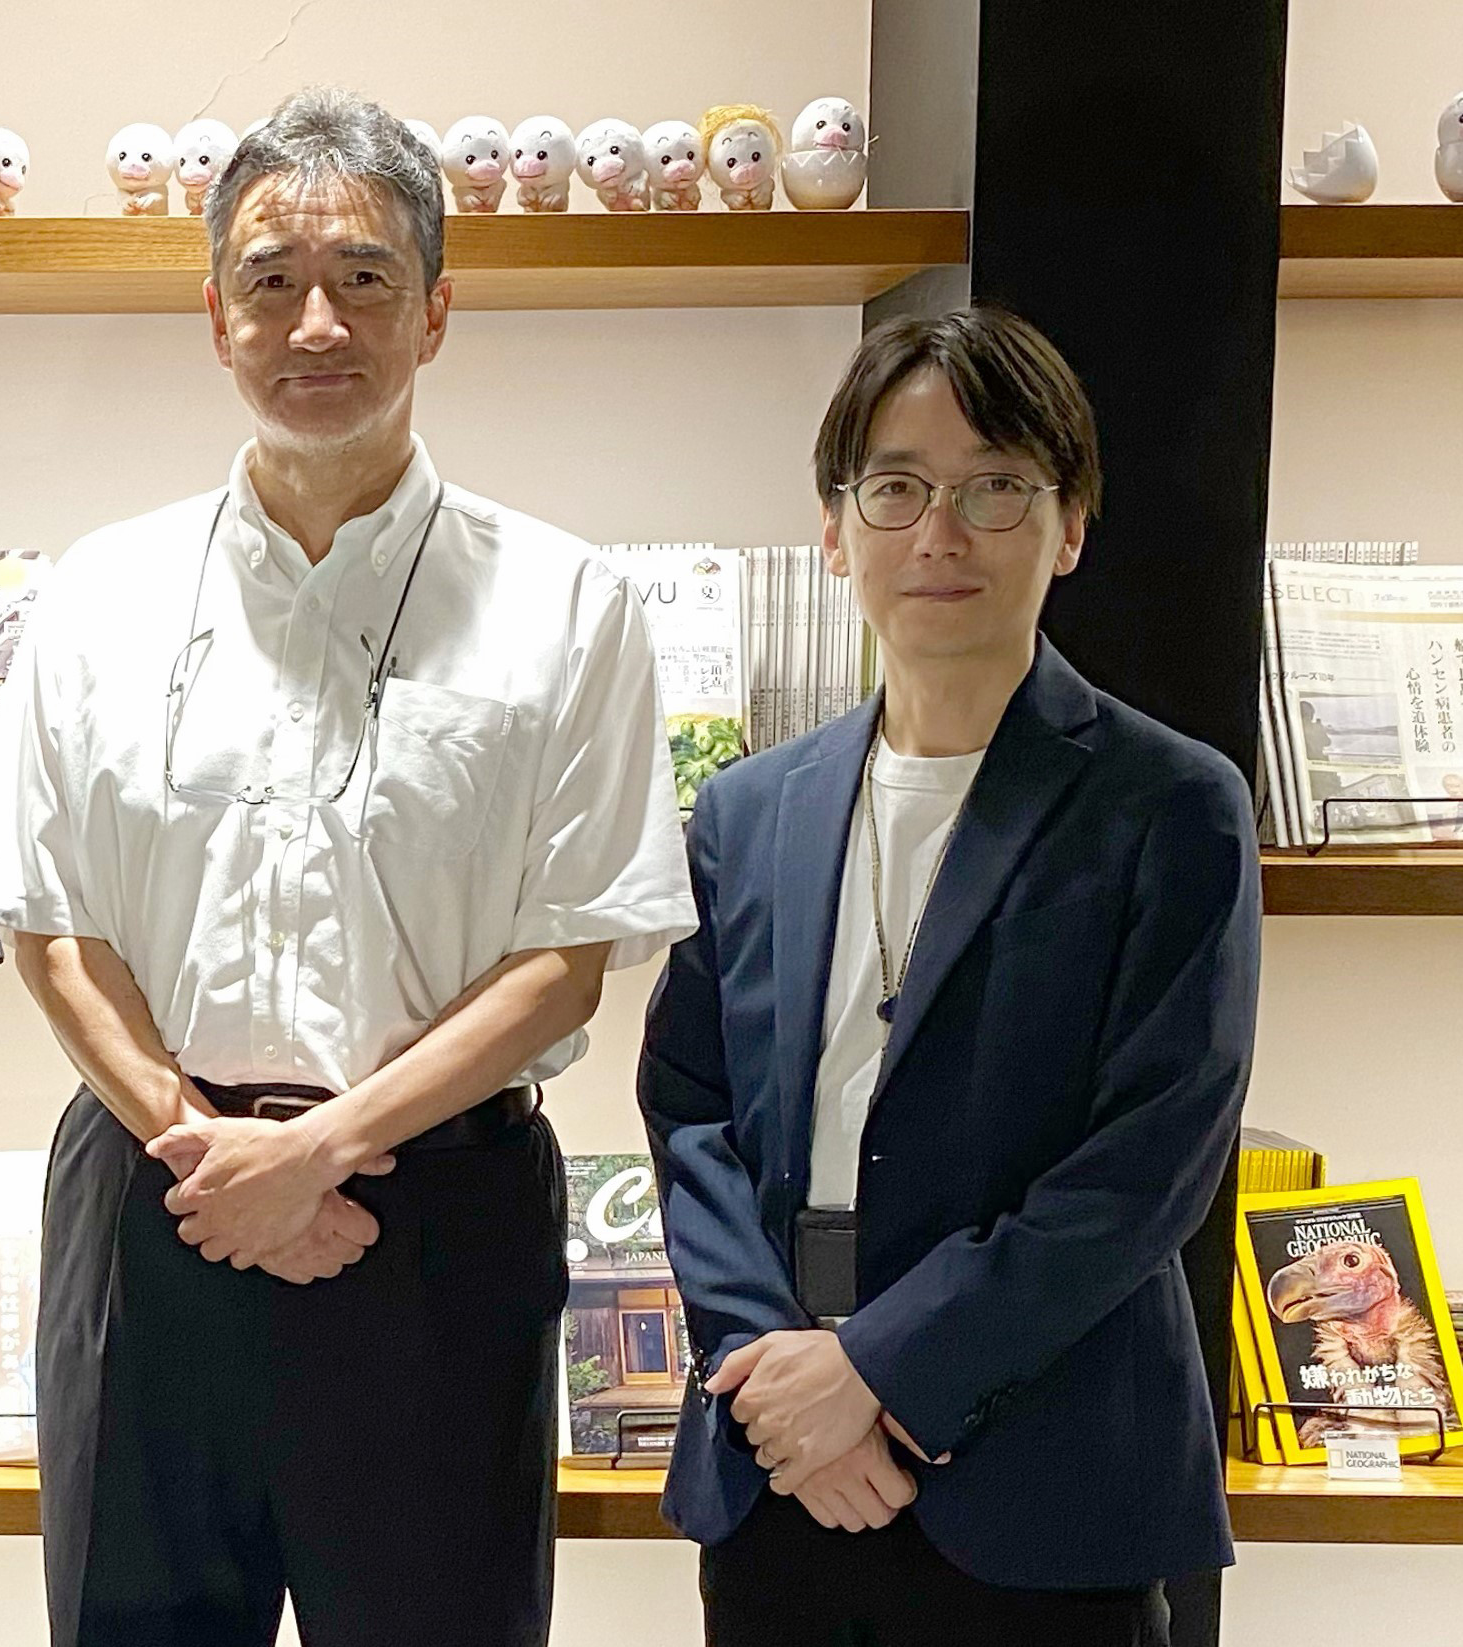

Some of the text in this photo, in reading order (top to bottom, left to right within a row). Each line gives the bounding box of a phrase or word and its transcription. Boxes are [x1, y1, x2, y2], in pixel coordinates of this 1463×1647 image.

[1294, 1219, 1371, 1241] NATIONAL
[1299, 1363, 1414, 1389] 嫌われがちな
[1344, 1384, 1436, 1406] 動物たち
[1346, 1451, 1387, 1460] NATIONAL
[1346, 1459, 1399, 1469] GEOGRAPHIC
